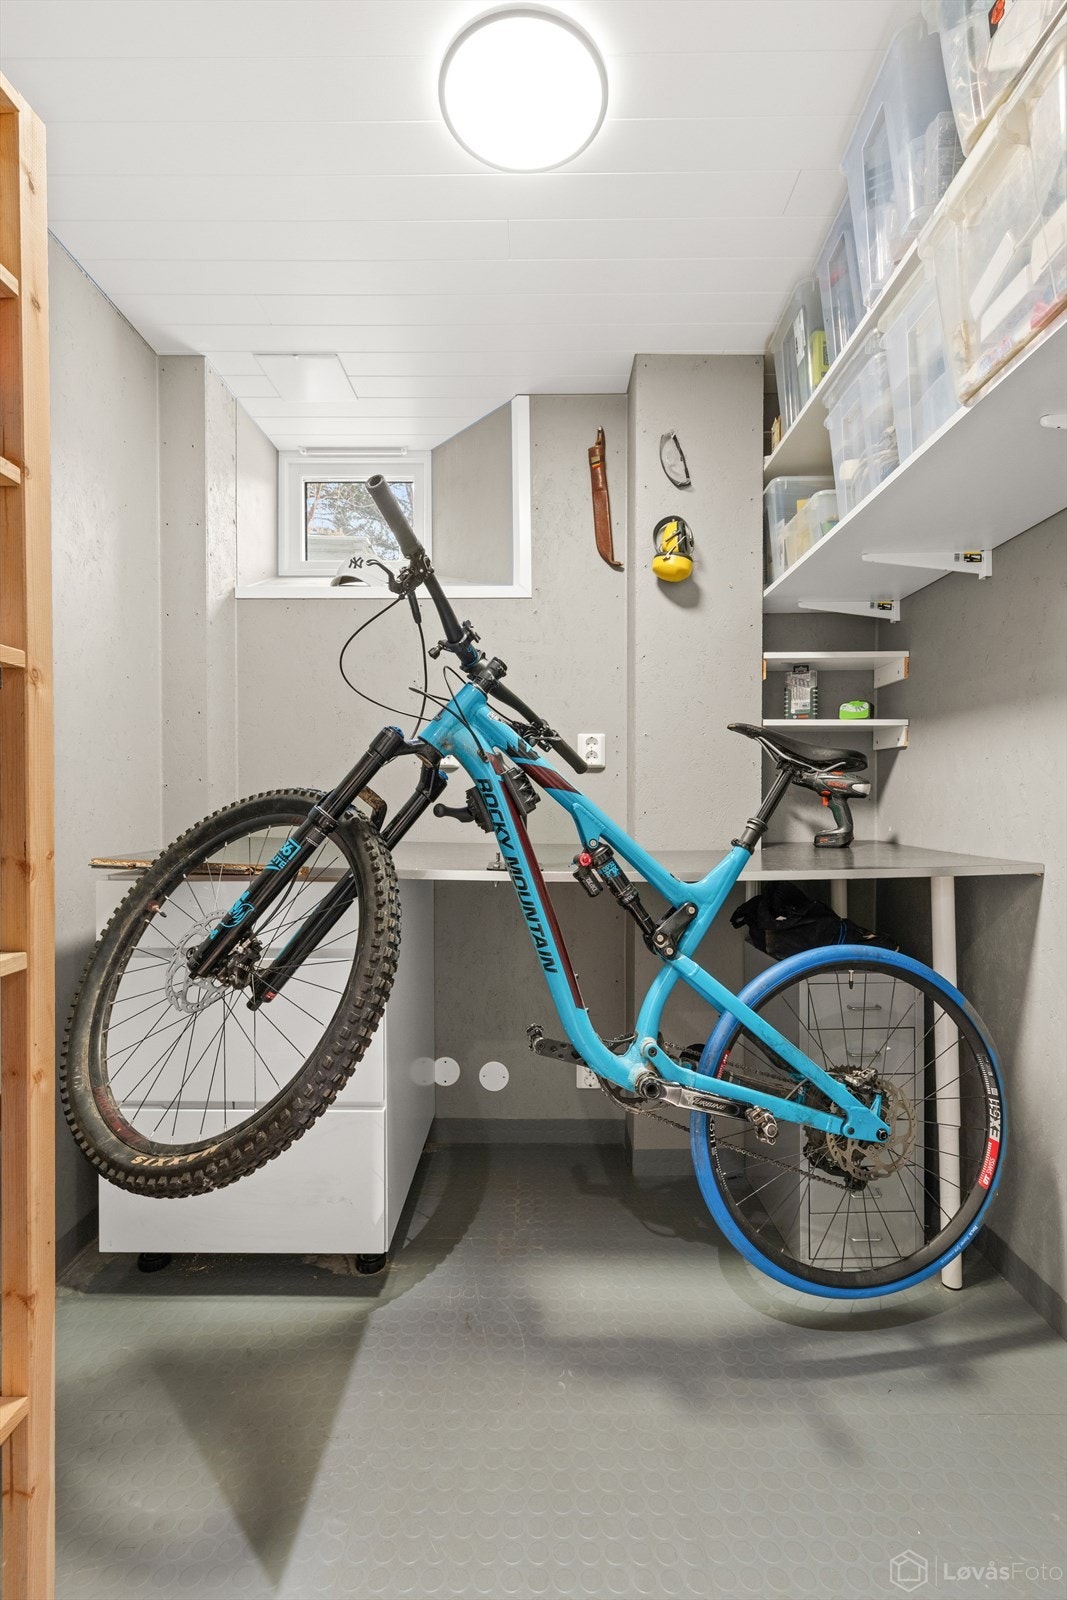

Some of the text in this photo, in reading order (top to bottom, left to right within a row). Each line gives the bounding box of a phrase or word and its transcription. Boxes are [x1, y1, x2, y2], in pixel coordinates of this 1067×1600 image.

[348, 556, 364, 569] NY
[476, 778, 559, 975] ROCKY MOUNTAIN
[989, 1098, 1001, 1142] EX511
